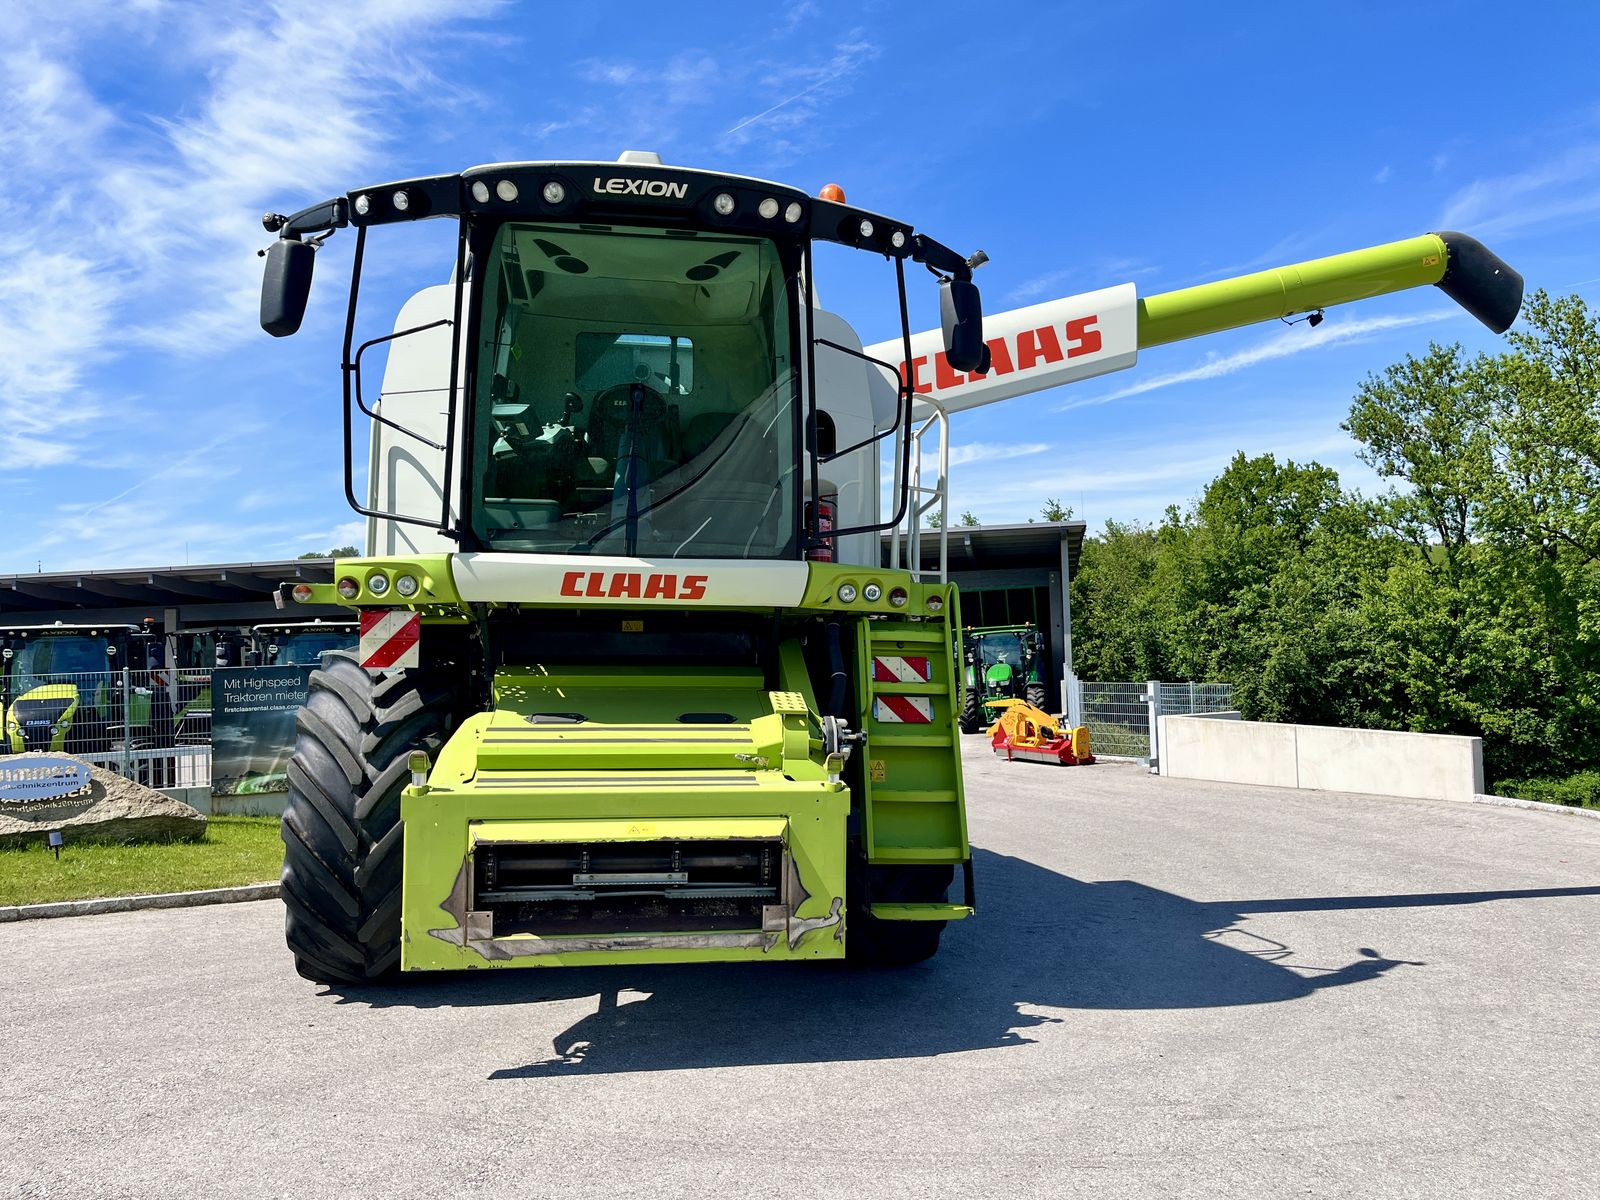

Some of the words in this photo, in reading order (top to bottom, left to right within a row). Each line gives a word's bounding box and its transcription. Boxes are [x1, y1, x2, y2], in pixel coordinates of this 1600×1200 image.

[593, 177, 689, 199] LEXION
[899, 314, 1102, 399] CLAAS
[560, 571, 709, 600] CLAAS
[224, 679, 241, 689] Mit
[243, 676, 301, 690] Highspeed
[224, 692, 273, 703] Traktoren
